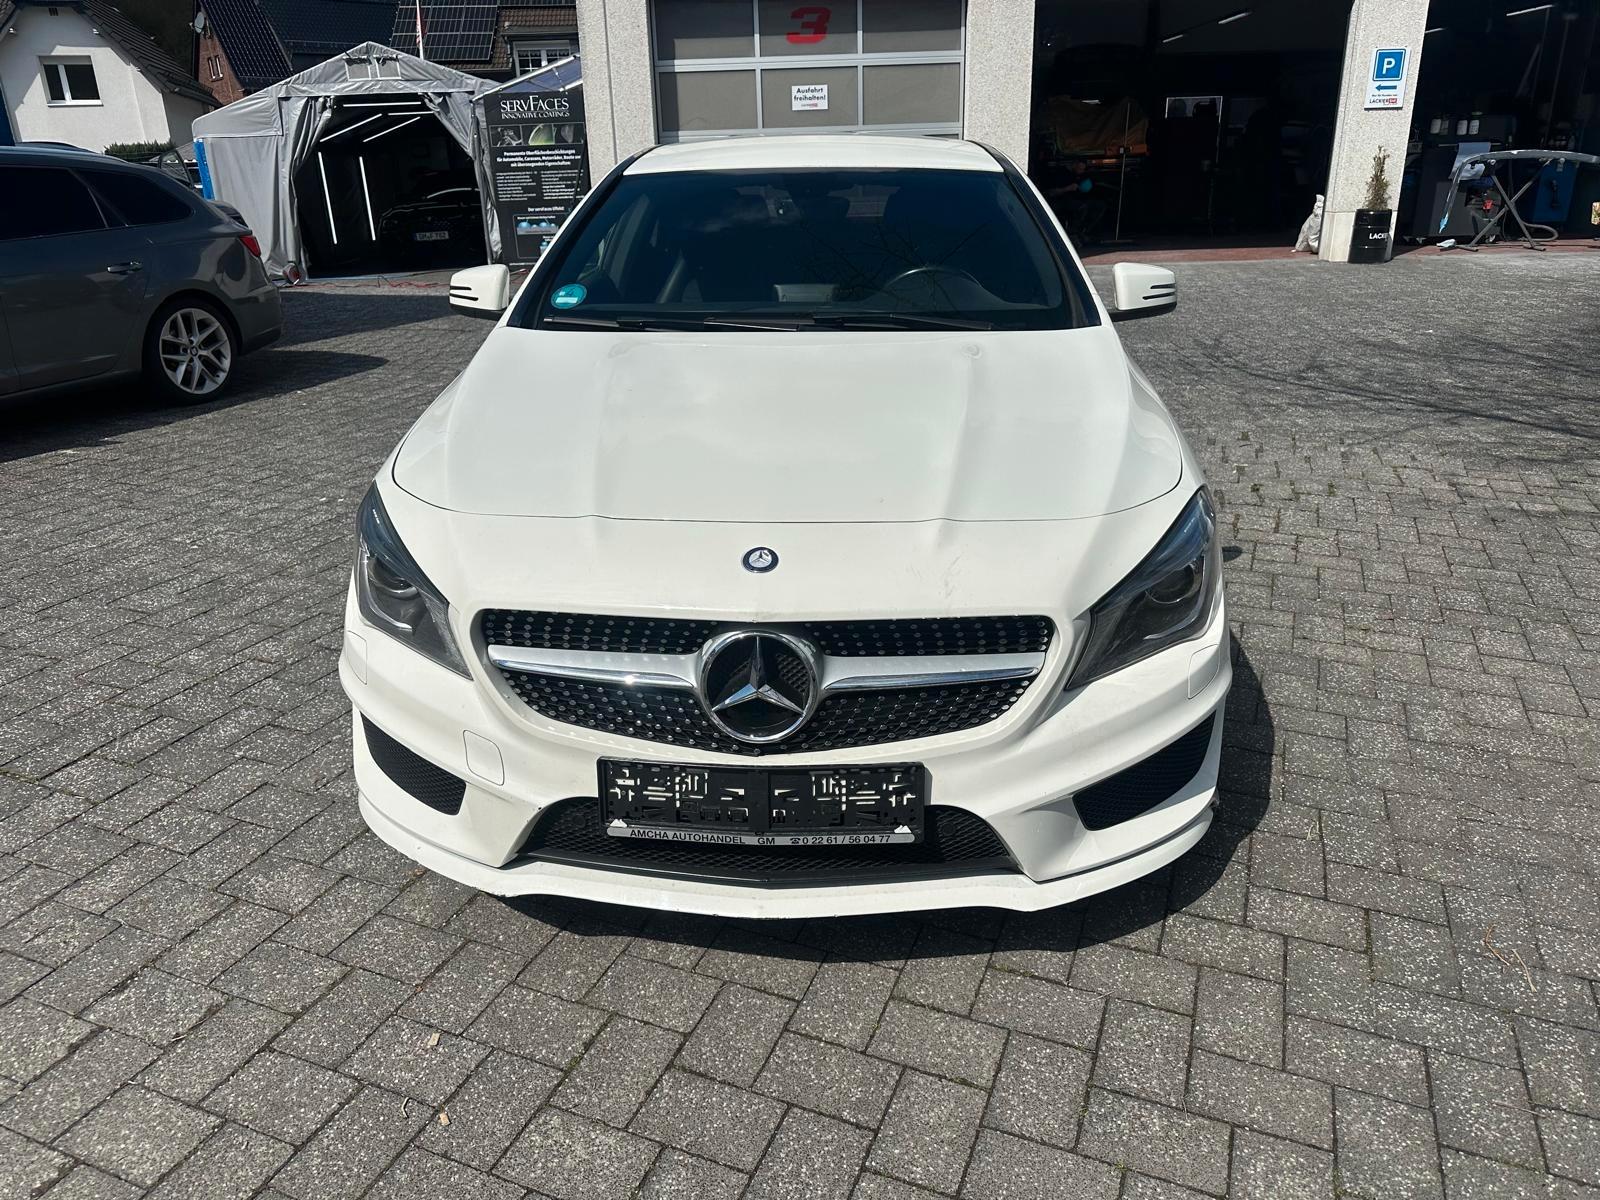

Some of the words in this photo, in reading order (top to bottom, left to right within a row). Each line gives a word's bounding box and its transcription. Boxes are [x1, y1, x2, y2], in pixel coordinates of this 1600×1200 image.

[785, 6, 831, 45] 3
[1382, 57, 1396, 75] P
[500, 95, 569, 112] SERVFACES
[793, 94, 826, 102] freihalten!
[501, 111, 537, 119] INNOVATIVE
[538, 110, 570, 118] COATINGS
[630, 829, 669, 840] AMCHA
[671, 833, 746, 844] AUTOHANDEL
[757, 837, 775, 845] GM
[826, 836, 838, 844] 61
[879, 835, 891, 843] 77
